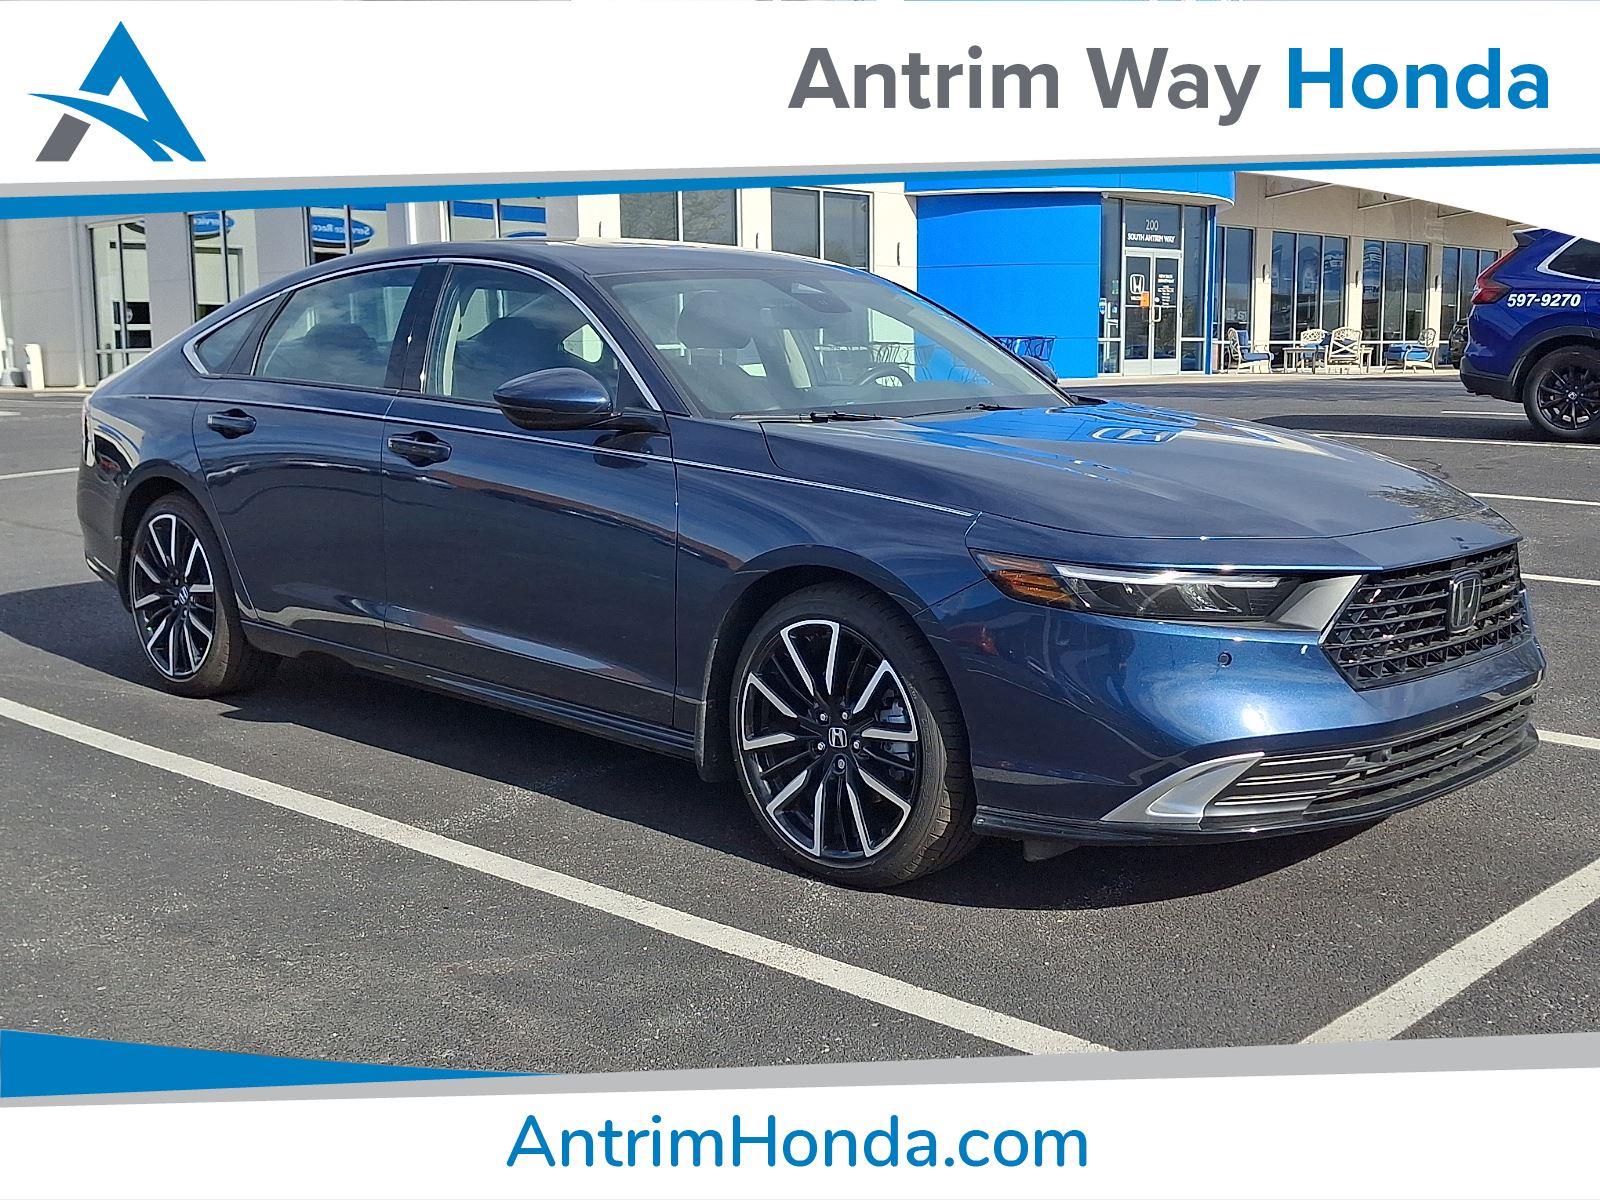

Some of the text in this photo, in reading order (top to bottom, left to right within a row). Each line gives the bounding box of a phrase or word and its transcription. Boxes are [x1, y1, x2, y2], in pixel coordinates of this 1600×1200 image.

[1145, 219, 1159, 231] 200
[1127, 233, 1175, 243] SOUTH ANTRIM WAY
[1507, 293, 1581, 308] 597-9270
